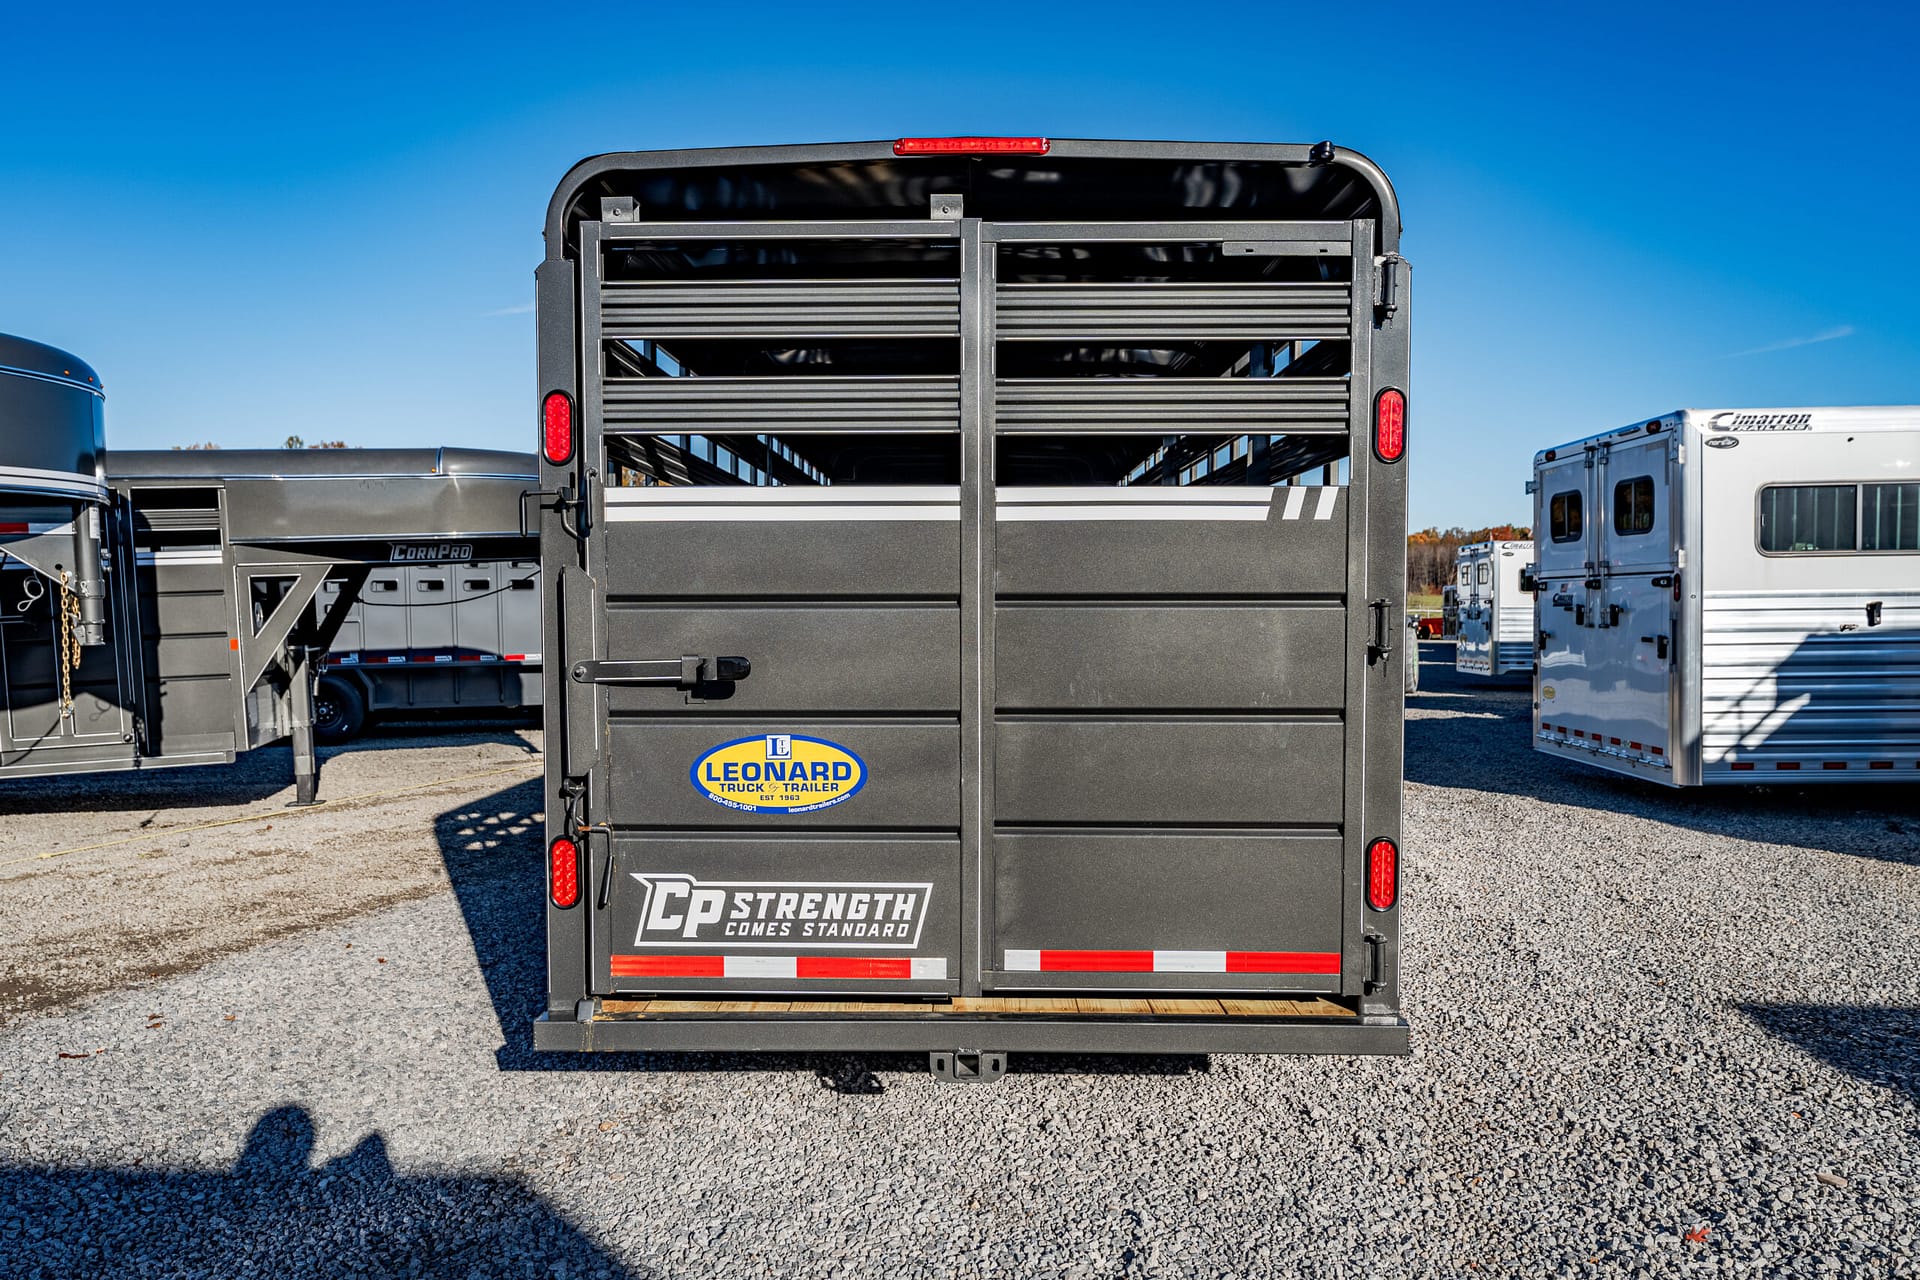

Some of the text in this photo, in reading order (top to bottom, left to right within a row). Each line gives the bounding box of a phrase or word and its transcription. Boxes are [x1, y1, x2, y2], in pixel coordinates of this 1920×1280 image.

[1708, 412, 1812, 431] Cimarron
[706, 761, 852, 782] LEONARD
[719, 783, 764, 793] TRUCK
[783, 782, 839, 792] TRAILER
[708, 792, 757, 812] 800-455-1001
[788, 793, 851, 813] leonardtrailers.com
[646, 881, 726, 938] CP
[730, 892, 917, 921] STRENGTH
[725, 921, 910, 937] COMES STANDARD
